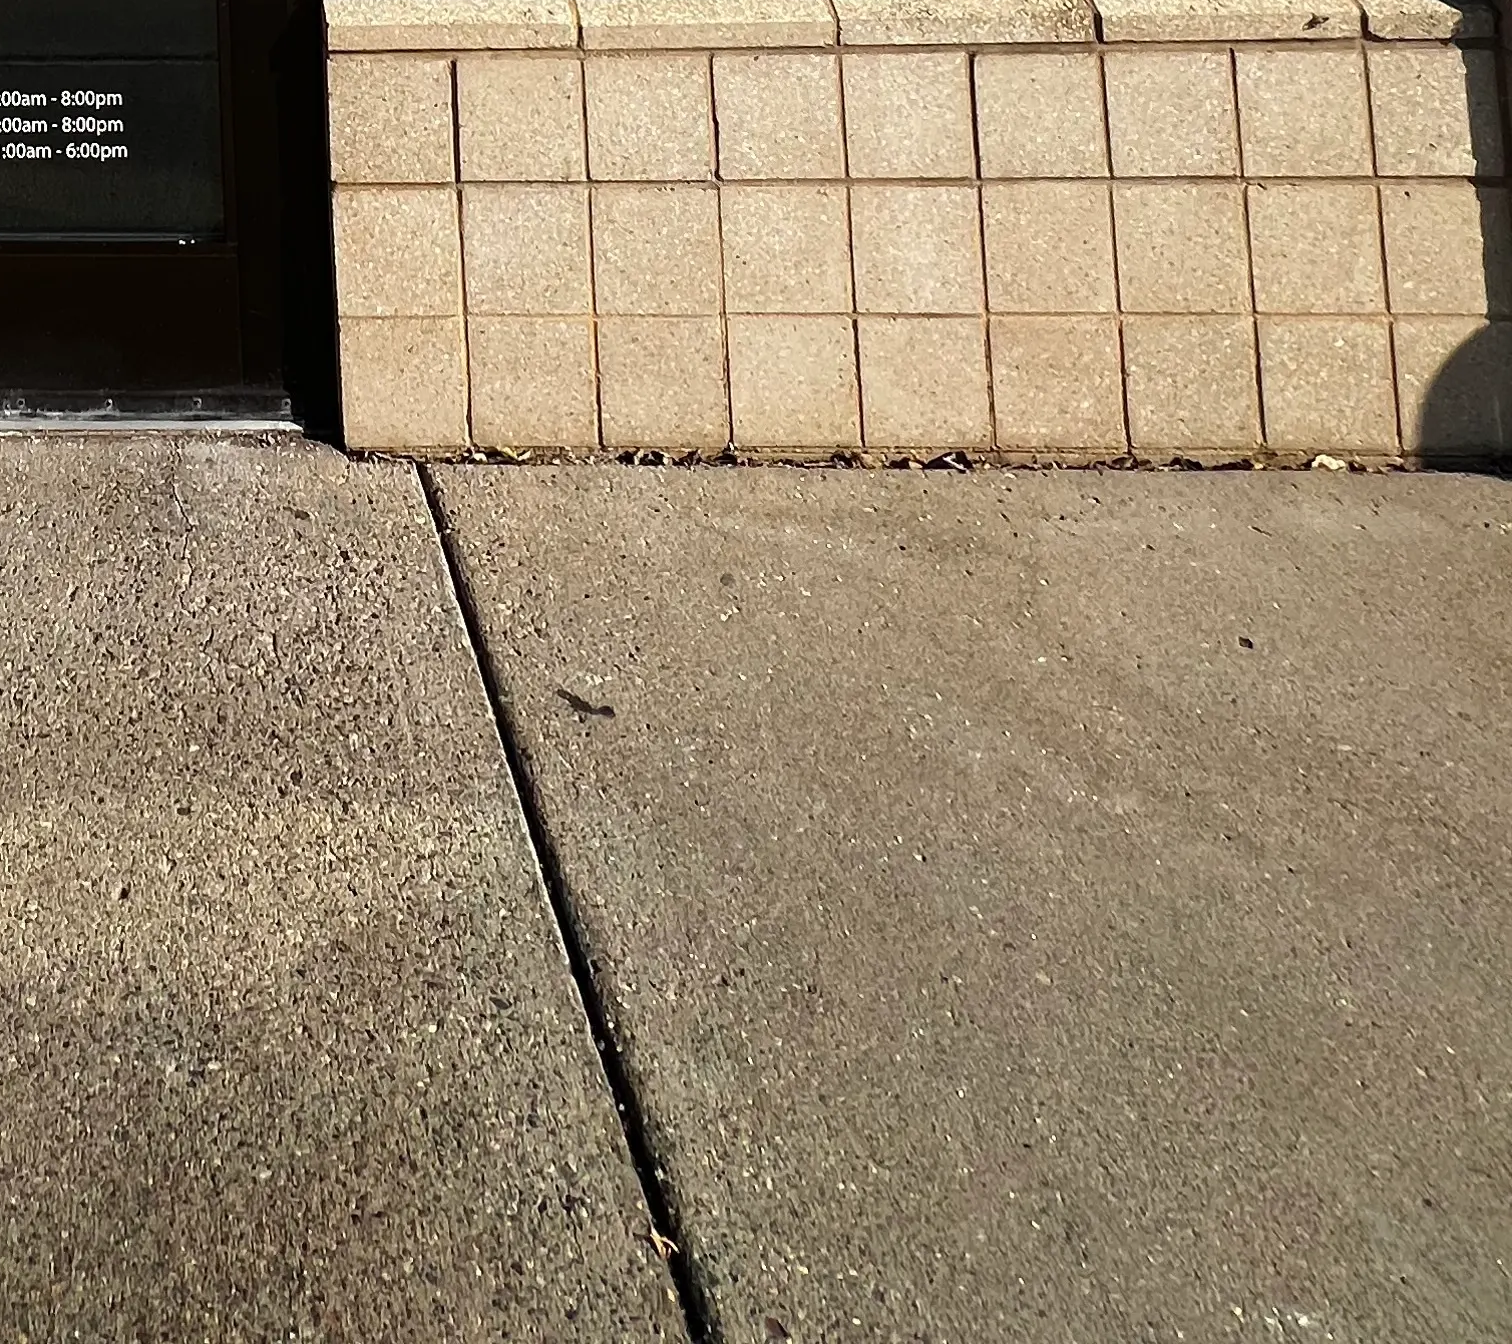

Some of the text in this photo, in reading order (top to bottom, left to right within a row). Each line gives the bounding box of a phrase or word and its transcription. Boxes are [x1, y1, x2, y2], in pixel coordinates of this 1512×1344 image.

[60, 90, 123, 109] 8:00pm
[61, 116, 124, 136] 8:00pm
[65, 142, 128, 162] 6:00pm
